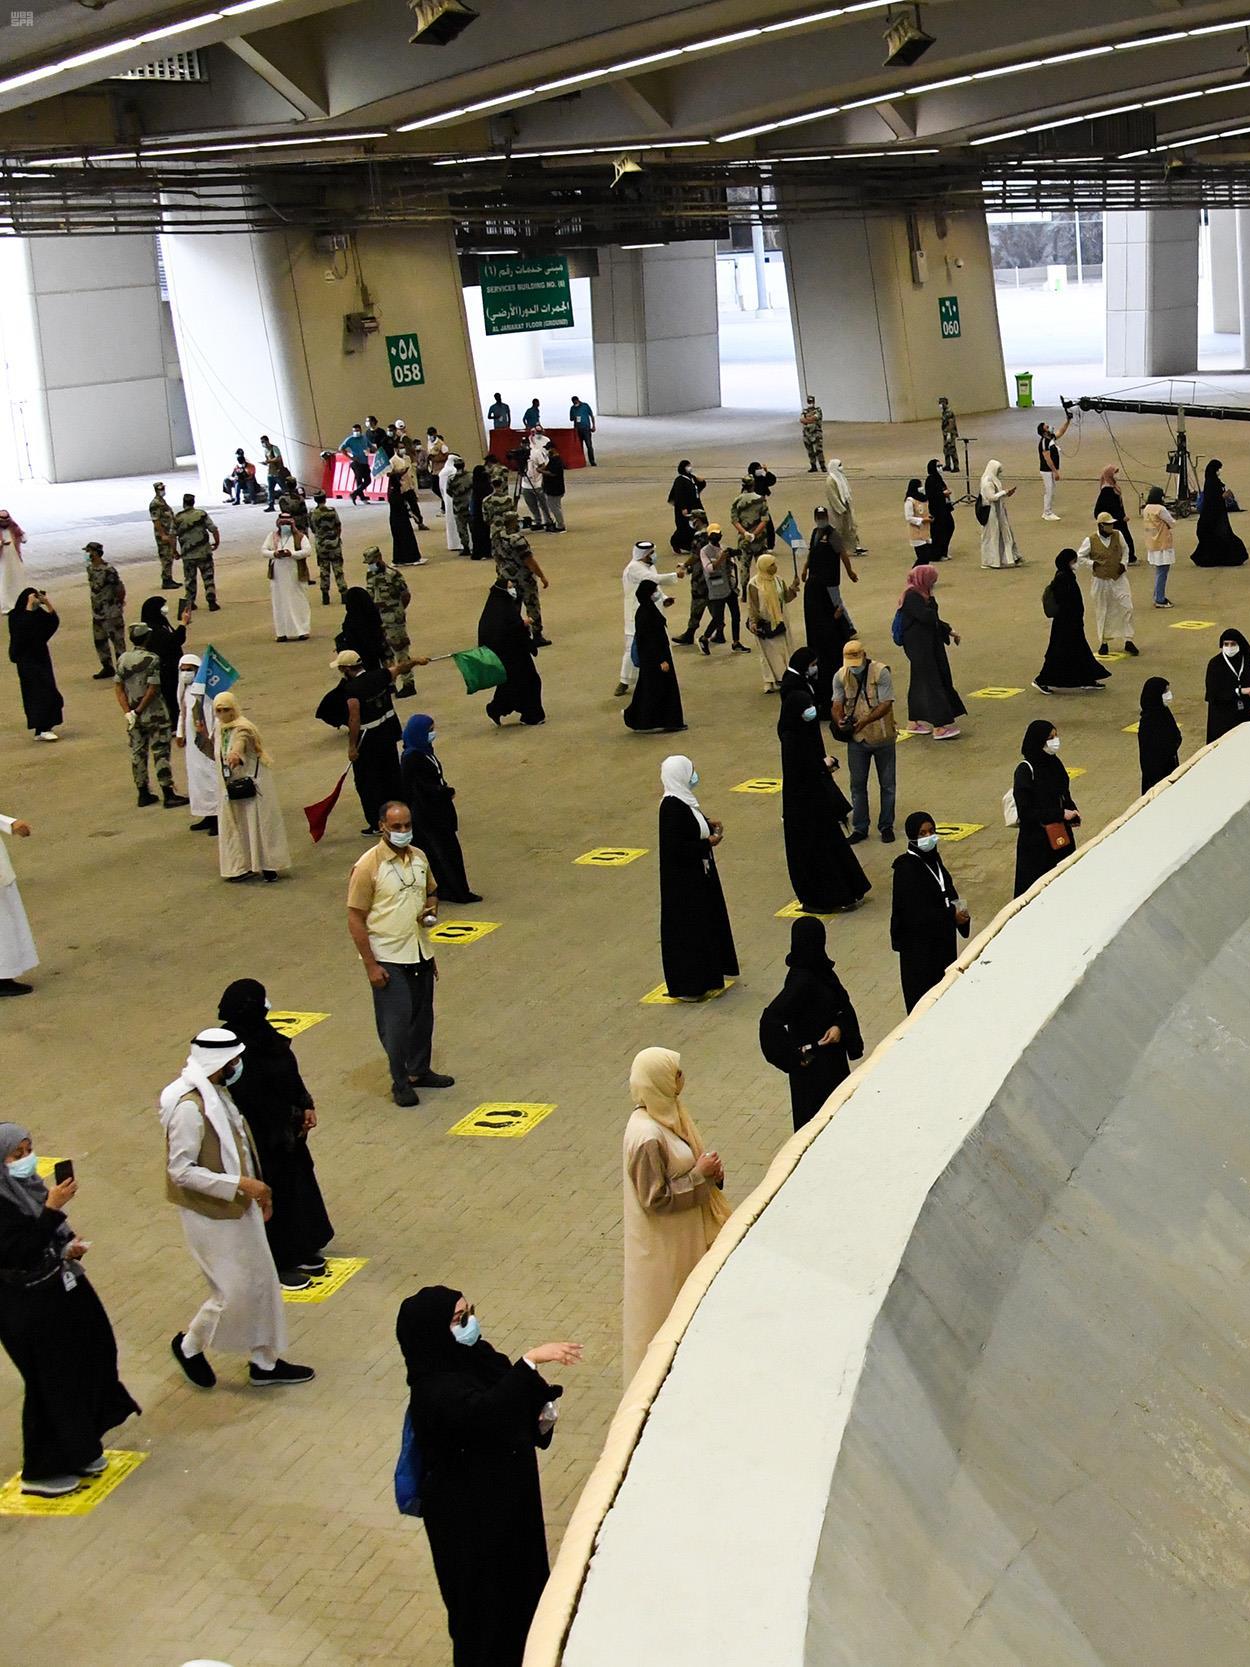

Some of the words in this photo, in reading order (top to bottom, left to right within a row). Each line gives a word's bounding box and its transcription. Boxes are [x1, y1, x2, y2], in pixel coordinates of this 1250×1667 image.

[498, 264, 514, 278] رقم
[515, 264, 543, 274] خدمات
[540, 301, 570, 315] الجمرات
[942, 300, 957, 317] ٠٦٠
[943, 320, 959, 335] 060
[390, 338, 418, 360] ٠٥٨
[394, 363, 421, 383] 058
